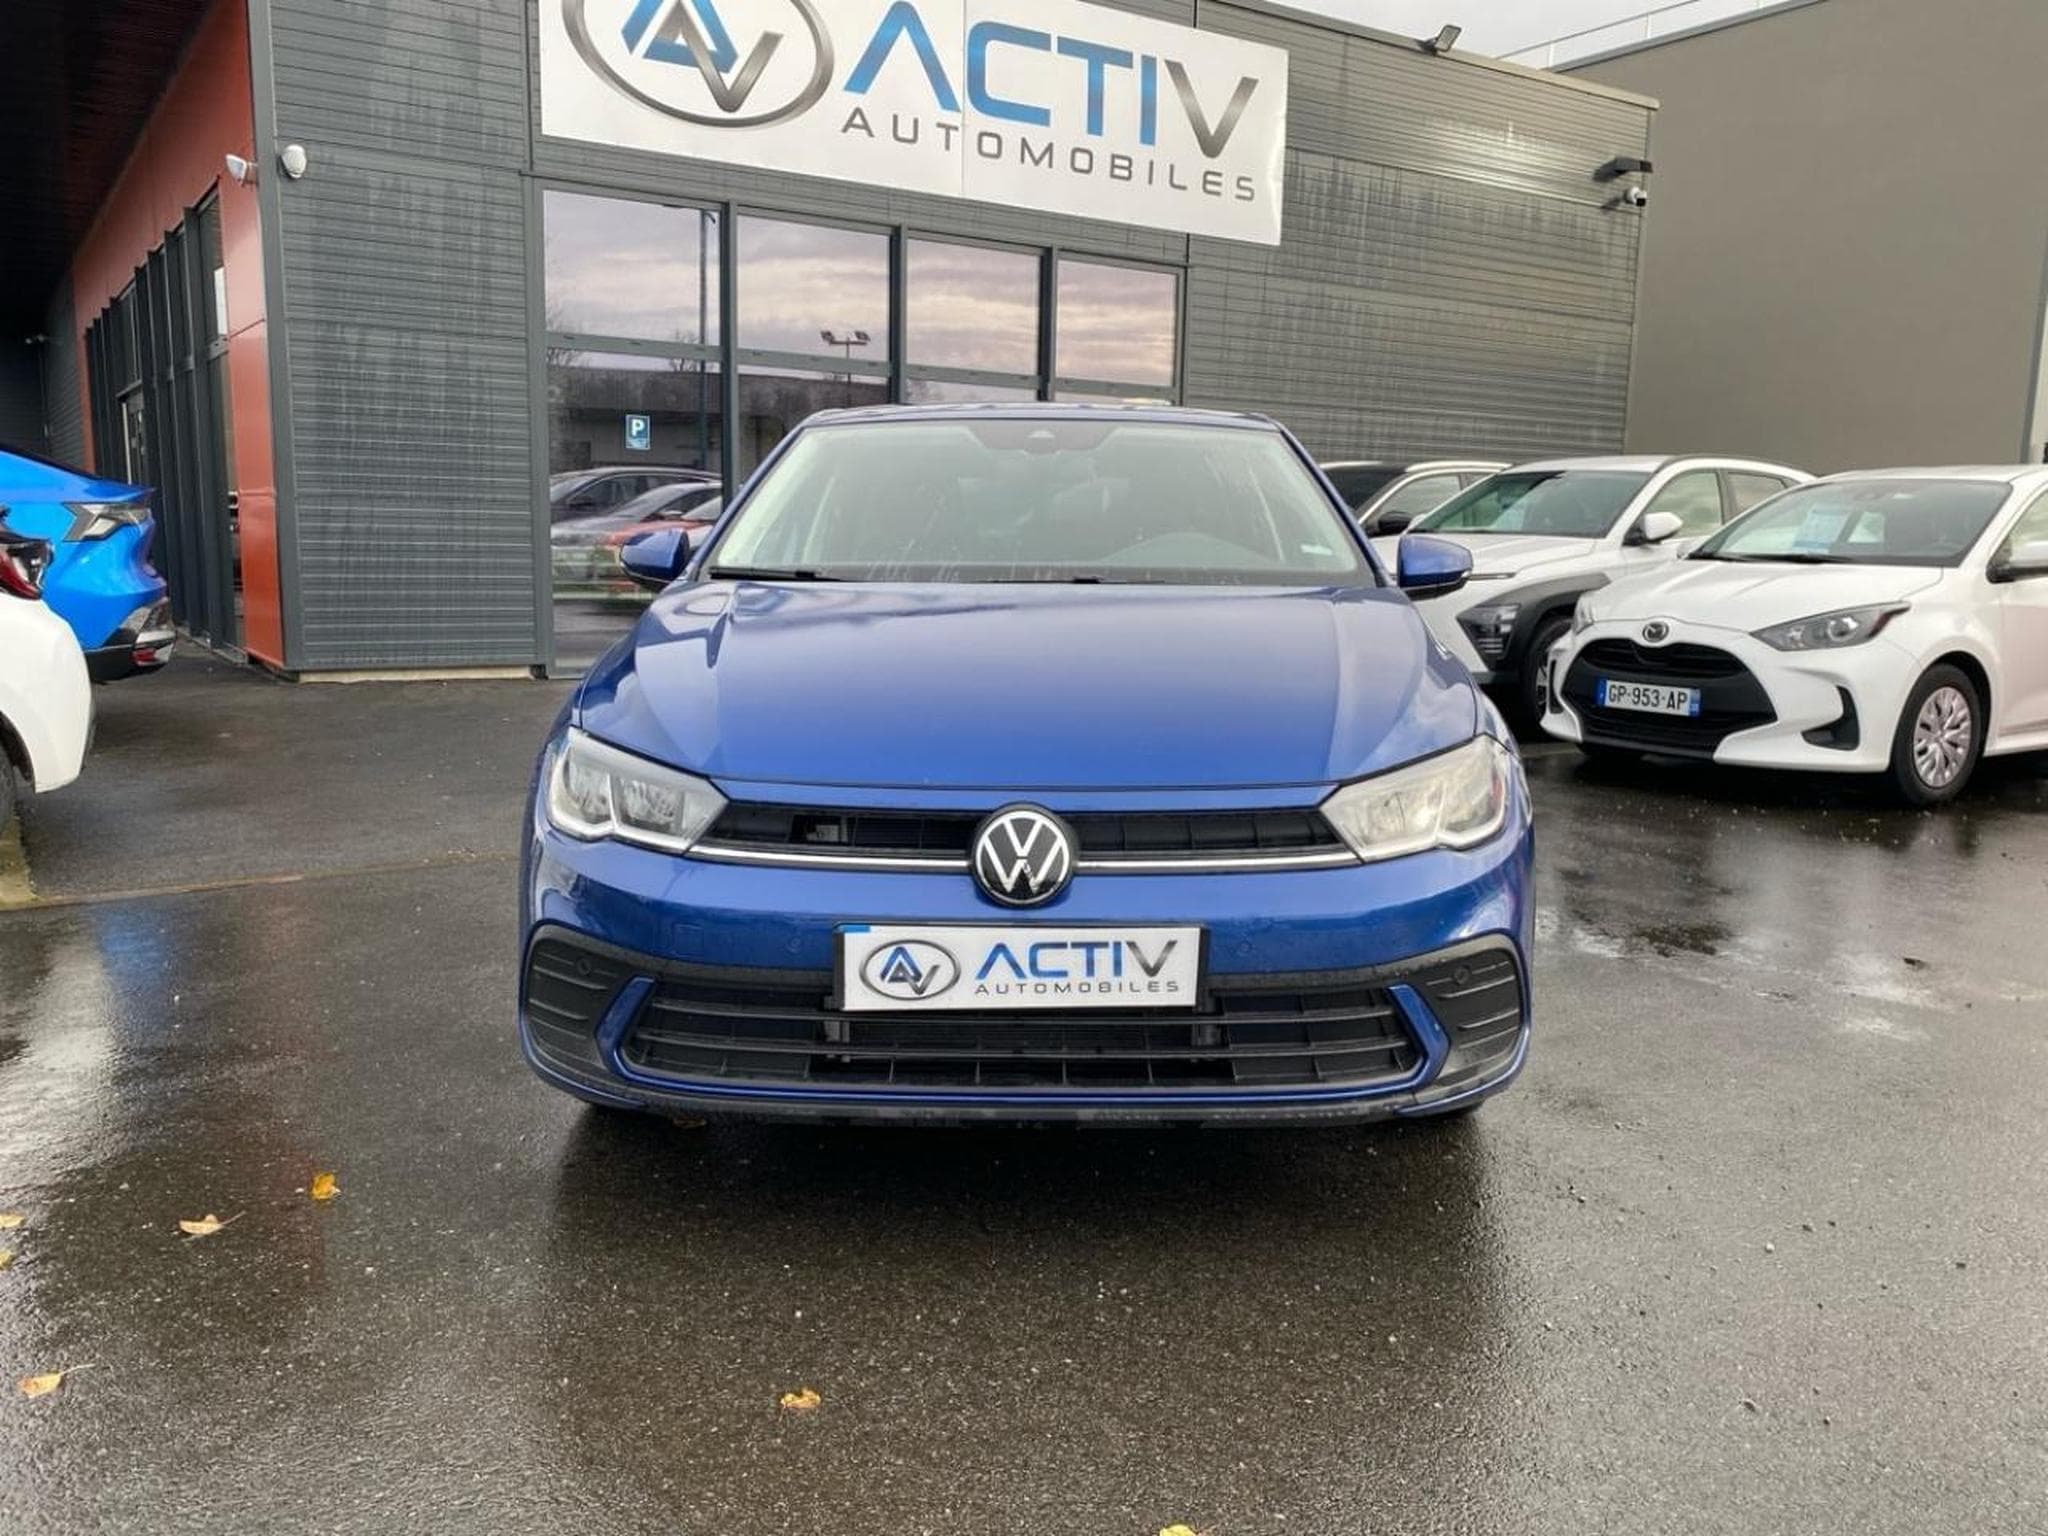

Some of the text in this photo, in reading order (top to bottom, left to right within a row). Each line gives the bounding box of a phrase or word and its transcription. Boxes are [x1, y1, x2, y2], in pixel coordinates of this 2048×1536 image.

[844, 0, 1259, 159] ACTIV
[842, 106, 1256, 202] AUTOMOBILES
[631, 418, 646, 437] P
[975, 940, 1178, 979] ACTIV
[975, 981, 1178, 995] AUTOMOBILES
